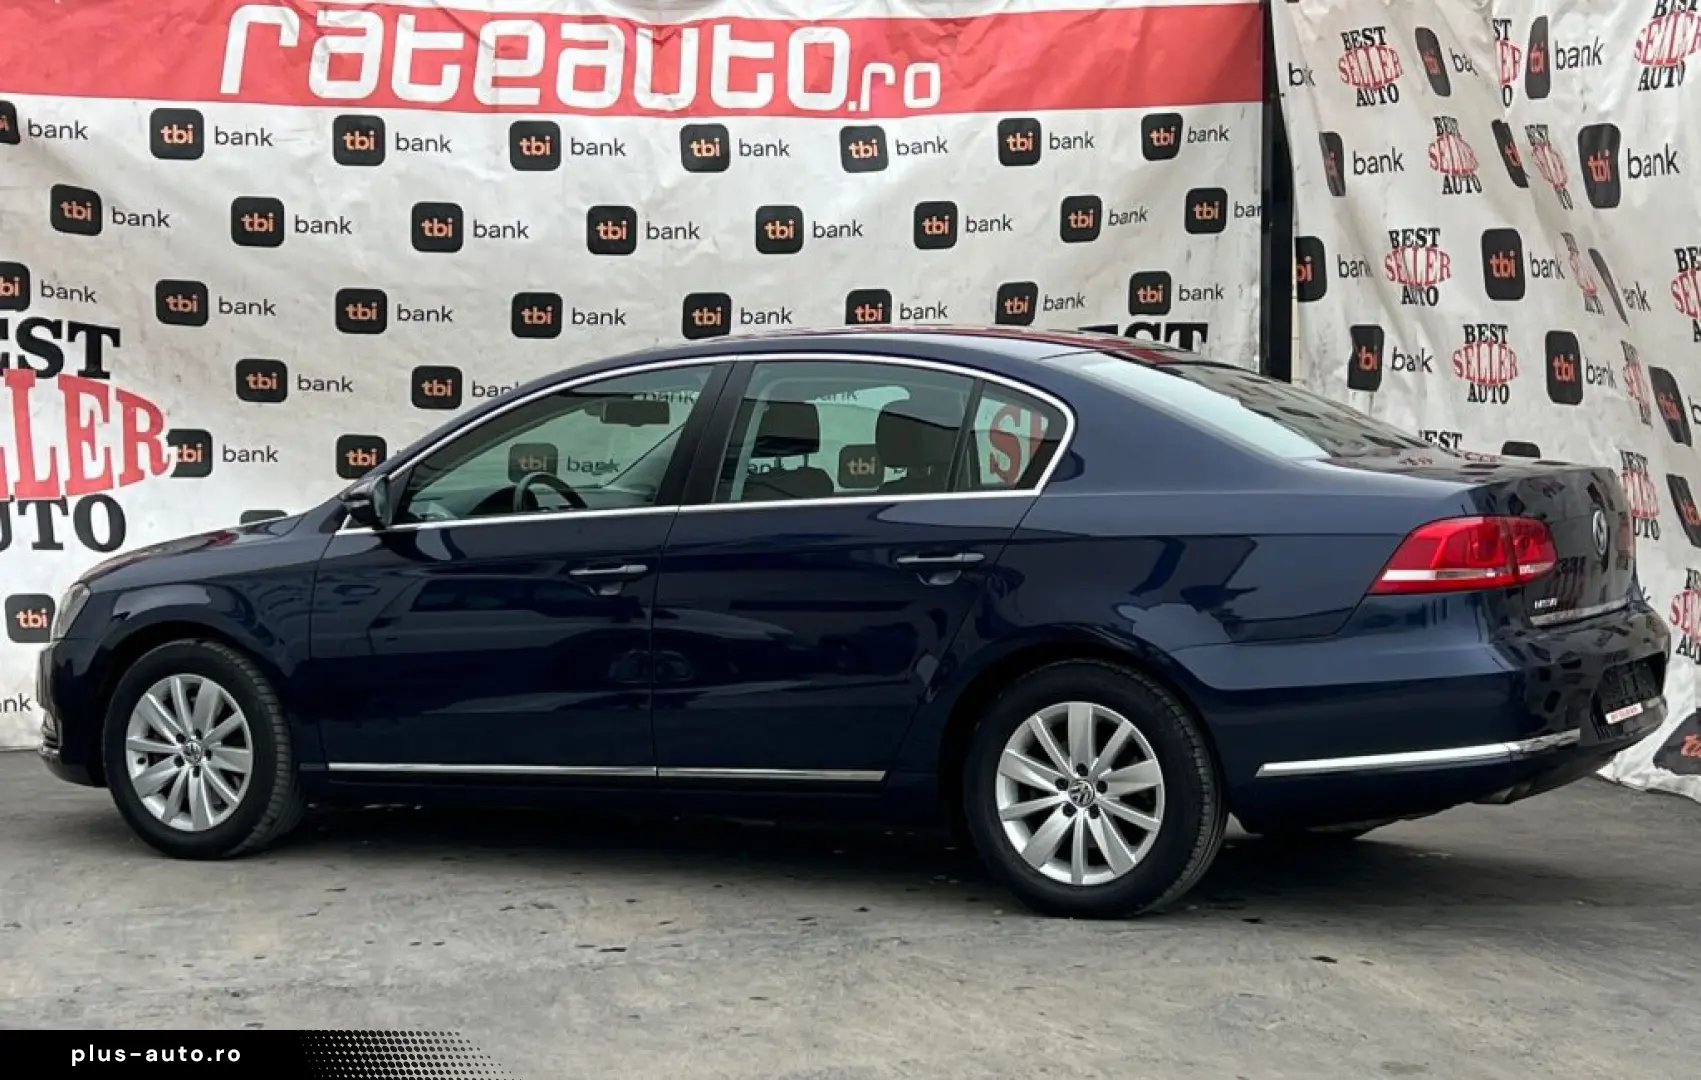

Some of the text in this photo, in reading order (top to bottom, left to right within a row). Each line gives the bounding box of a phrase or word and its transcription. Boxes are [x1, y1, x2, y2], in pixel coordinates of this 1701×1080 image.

[1341, 27, 1386, 50] BEST
[220, 4, 940, 111] rateauto.ro
[1555, 36, 1604, 70] bank
[1338, 46, 1403, 88] SELLER
[1357, 83, 1399, 107] AUTO
[28, 118, 88, 140] bank
[161, 124, 274, 147] tbi bank
[1150, 124, 1229, 146] tbi bank
[342, 130, 452, 153] tbi bank
[520, 136, 626, 157] tbi bank
[690, 138, 790, 157] tbi bank
[849, 136, 949, 158] tbi bank
[1006, 131, 1095, 151] tbi bank
[1353, 146, 1404, 175] bank
[1628, 143, 1680, 179] bank
[61, 201, 171, 228] tbi bank
[1068, 206, 1148, 228] tbi bank
[1194, 201, 1219, 219] tbi
[241, 213, 352, 234] tbi bank
[422, 218, 529, 239] tbi bank
[596, 221, 700, 240] tbi bank
[764, 219, 864, 239] tbi bank
[922, 214, 1013, 234] tbi bank
[1389, 228, 1440, 248] BEST
[1490, 250, 1516, 278] tbi
[1674, 246, 1701, 272] BE
[0, 276, 97, 304] bi bank
[1138, 283, 1224, 303] tbi bank
[166, 294, 276, 316] tbi bank
[346, 302, 453, 322] tbi bank
[855, 301, 948, 322] tbi bank
[1005, 292, 1085, 314] tbi bank
[521, 306, 626, 326] tbi bank
[692, 306, 792, 326] tbi bank
[1463, 324, 1508, 344] BEST
[0, 317, 120, 379] ST
[1453, 341, 1519, 384] SELLER
[246, 372, 353, 392] tbi bank
[422, 379, 452, 396] tbi
[1467, 384, 1510, 404] AUTO
[0, 369, 170, 498] LER
[223, 444, 278, 462] bank
[346, 448, 377, 466] tbi
[847, 456, 876, 475] tbi
[16, 608, 47, 628] tbi
[0, 693, 31, 712] nk
